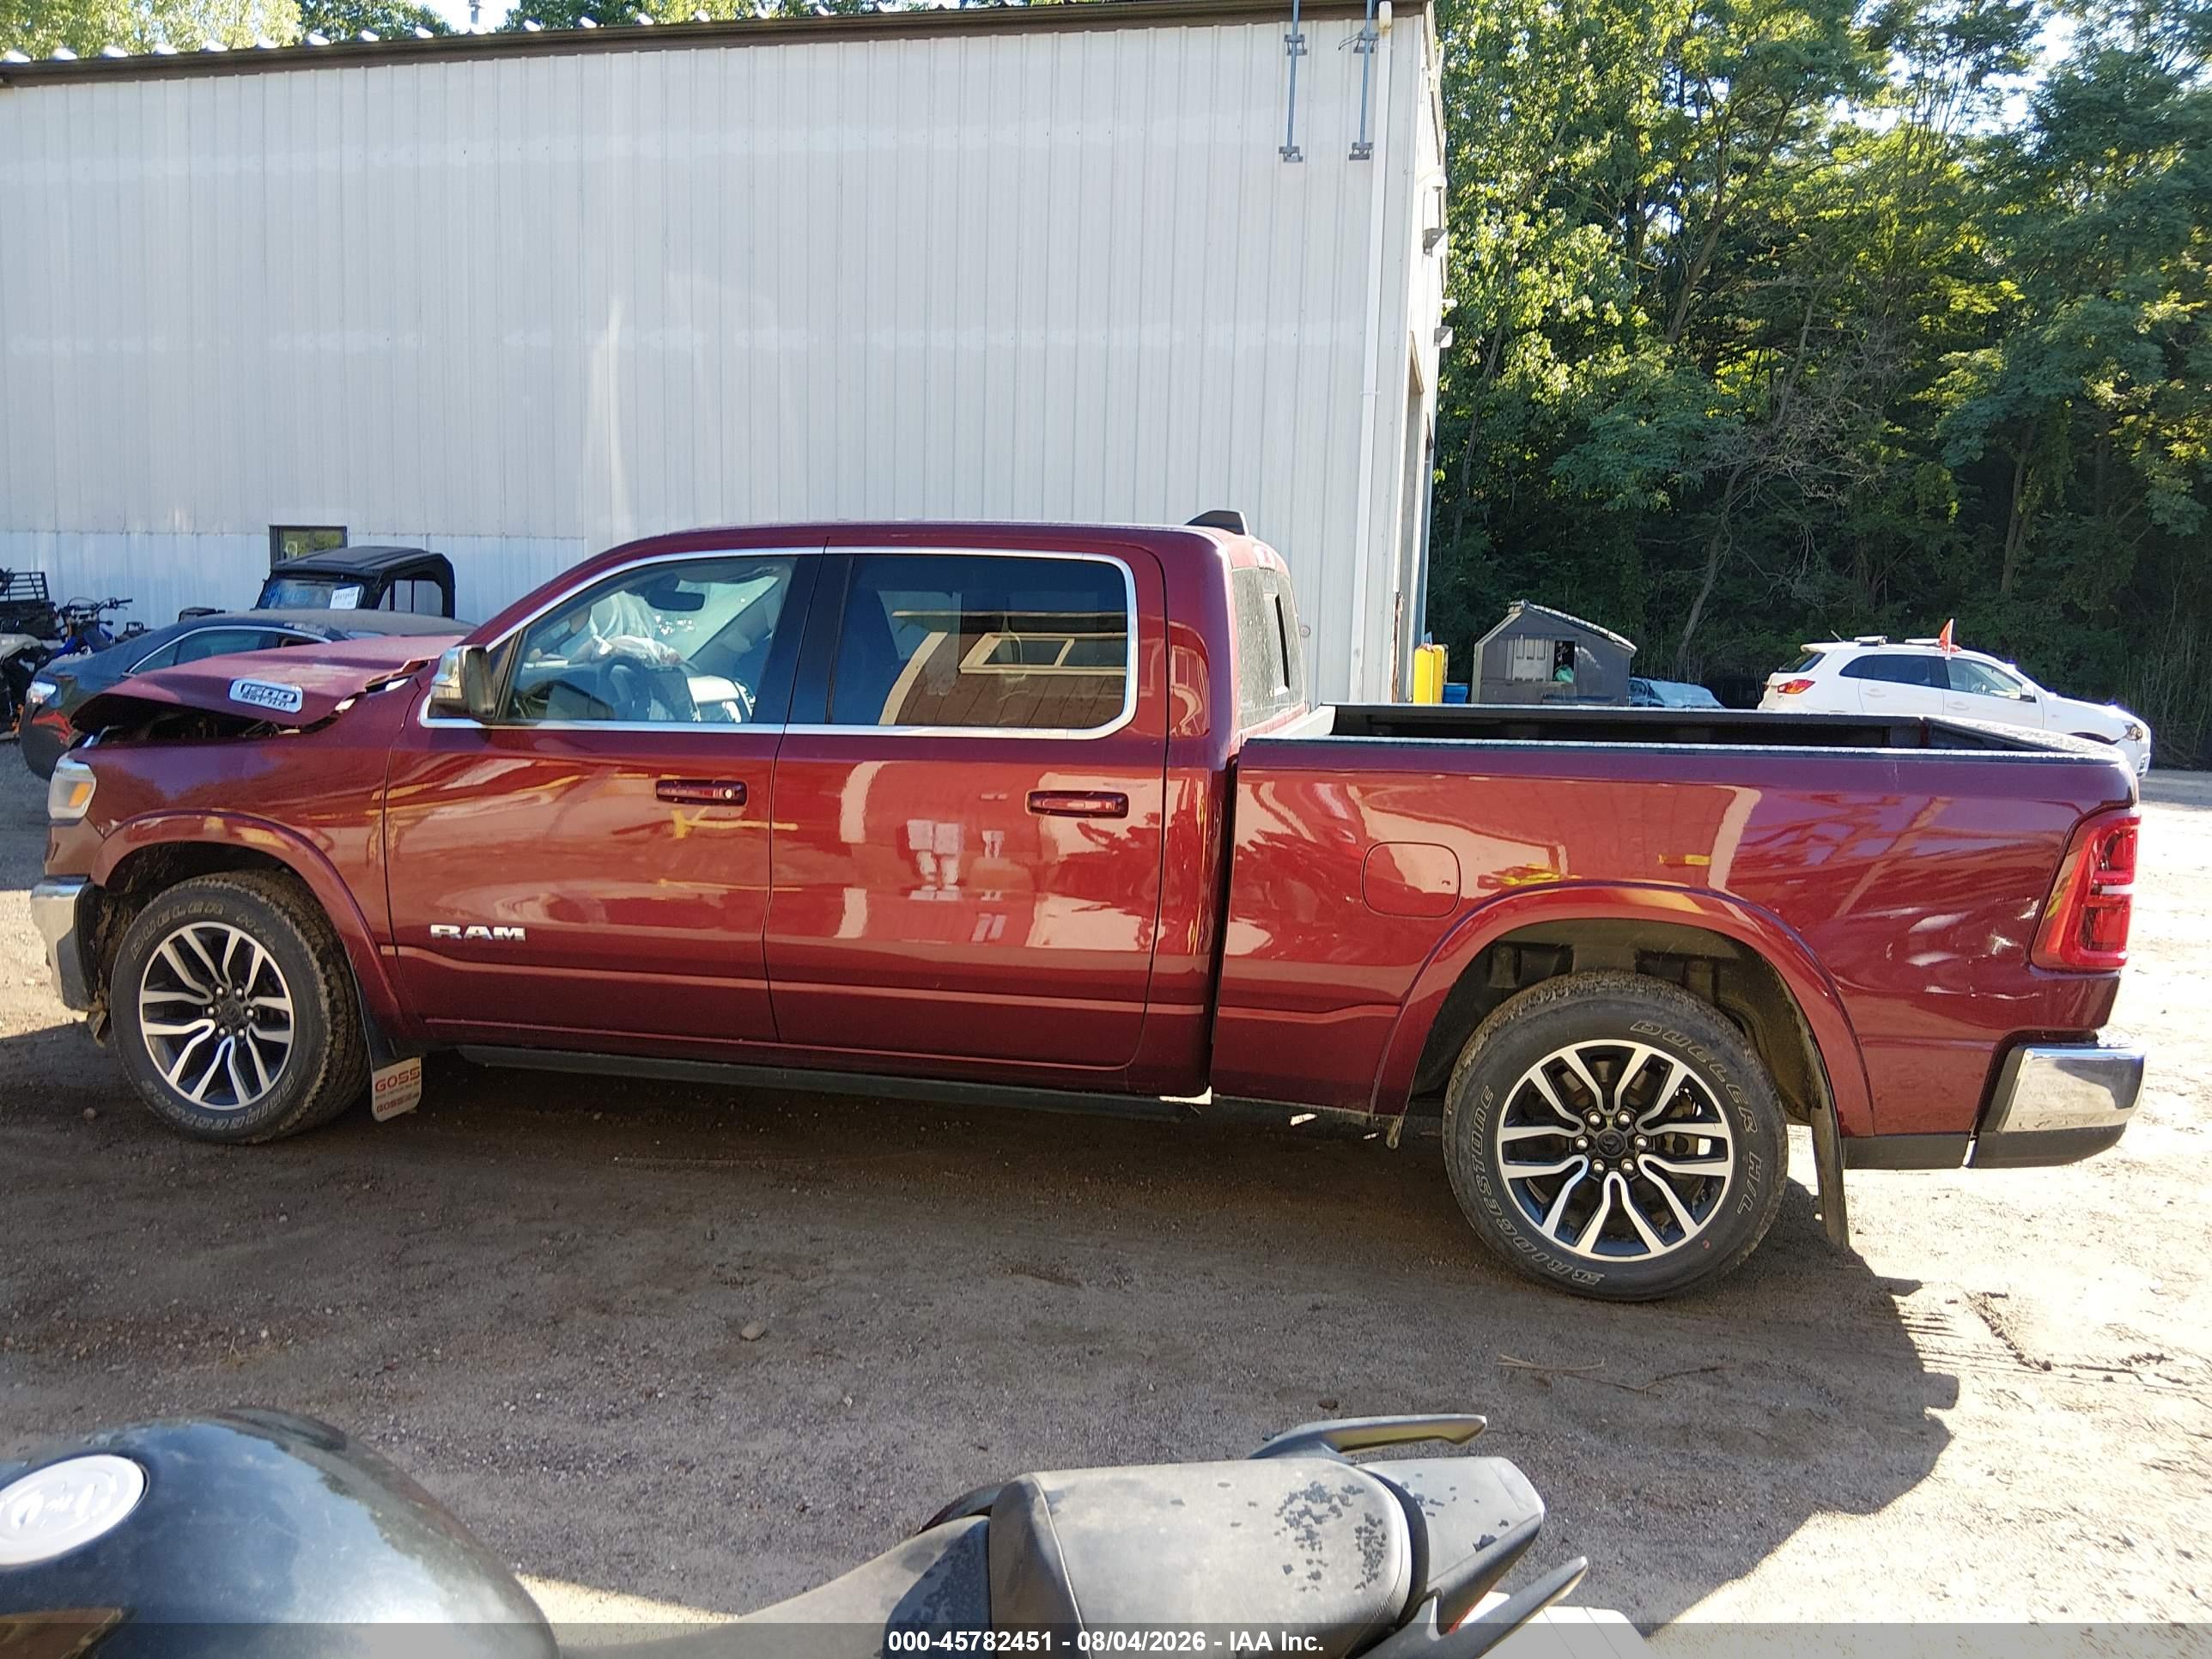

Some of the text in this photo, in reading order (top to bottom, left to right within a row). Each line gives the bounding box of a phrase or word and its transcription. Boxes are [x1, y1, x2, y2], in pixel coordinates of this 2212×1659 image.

[241, 684, 295, 702] 1500
[430, 924, 526, 942] RAM
[375, 1066, 421, 1093] GOSS
[1630, 1019, 1762, 1215] DUELER H/L
[1470, 1084, 1606, 1285] BRIDGESTONE
